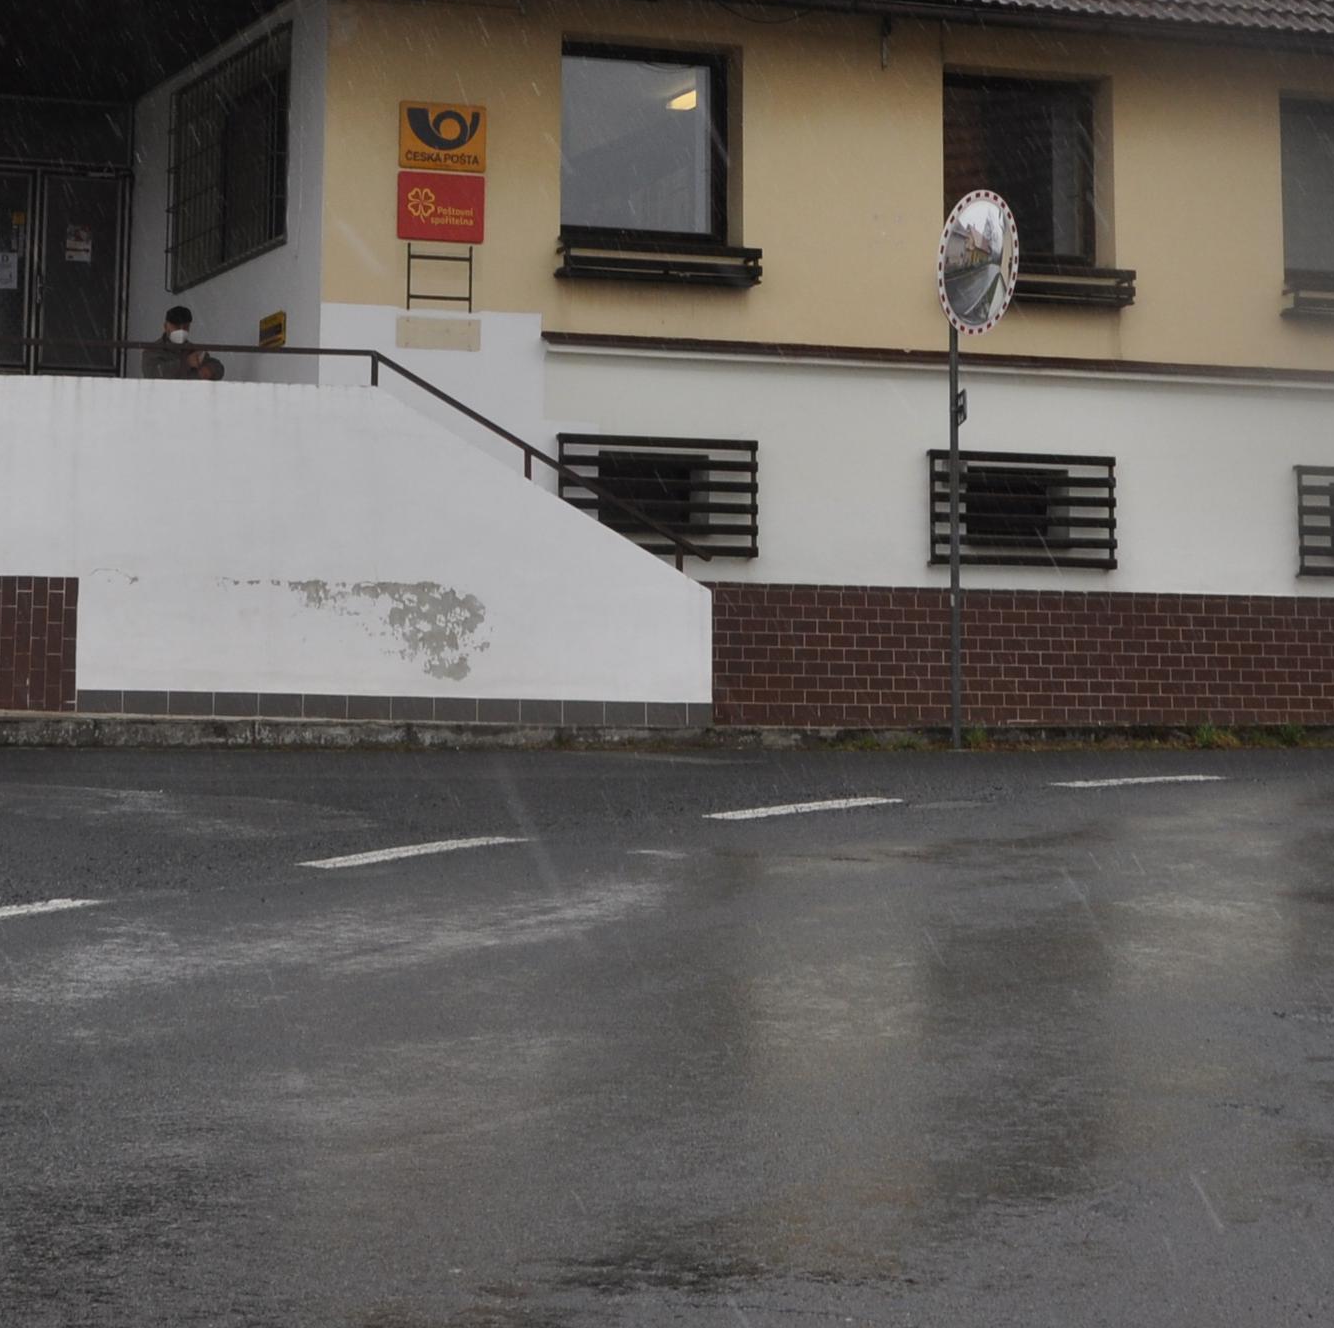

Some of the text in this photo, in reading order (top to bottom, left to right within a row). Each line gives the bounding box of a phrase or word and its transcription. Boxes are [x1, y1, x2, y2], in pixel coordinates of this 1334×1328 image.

[405, 150, 479, 165] ČESKÁ POŠTA
[437, 206, 474, 217] Poštovní
[430, 215, 474, 226] spořitelna
